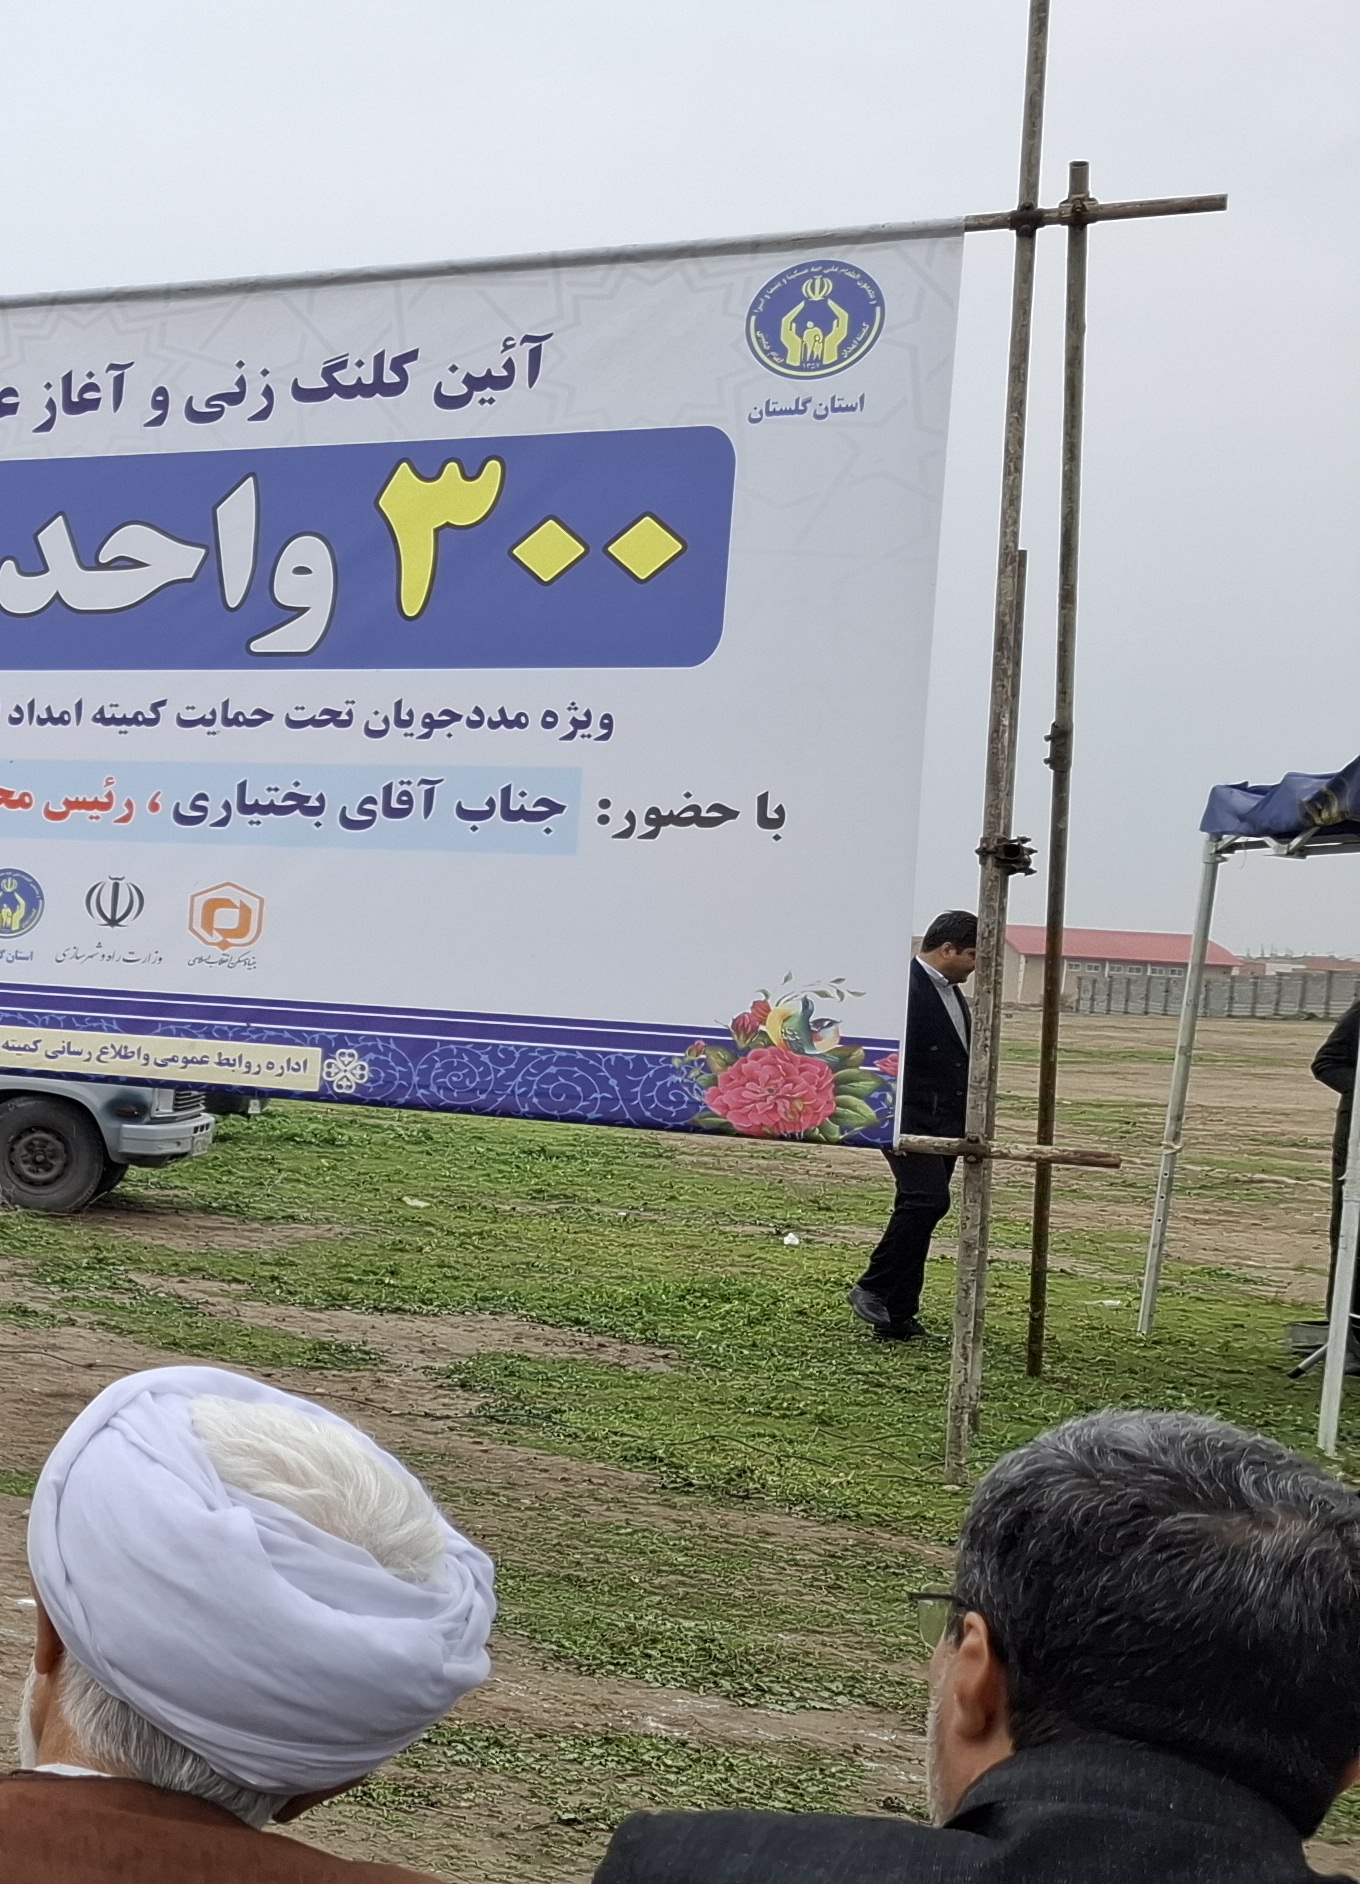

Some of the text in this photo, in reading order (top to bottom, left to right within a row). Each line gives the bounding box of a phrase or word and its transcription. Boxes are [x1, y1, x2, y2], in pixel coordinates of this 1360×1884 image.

[184, 358, 276, 424] زنی
[289, 347, 419, 406] کلنگ
[432, 331, 555, 409] آئین
[32, 359, 134, 434] آغاز
[142, 385, 168, 429] و
[748, 393, 865, 424] استان گلستان
[376, 454, 688, 620] ۳۰۰
[6, 698, 83, 728] امداد
[89, 698, 169, 735] کمیته
[175, 696, 274, 735] حمایت
[285, 700, 354, 732] تحت
[362, 698, 530, 741] مددجویان
[540, 701, 615, 743] ویژه
[42, 776, 134, 823] رئیس
[172, 776, 326, 832] بختیاری
[338, 776, 444, 832] آقای
[454, 781, 567, 834] جناب
[596, 791, 740, 841] حضور:
[754, 791, 787, 843] با
[6, 949, 34, 963] استان
[122, 951, 162, 964] وزارت
[2, 1037, 42, 1056] کمیته
[44, 1041, 92, 1062] رسانی
[153, 1052, 210, 1069] عمومی
[214, 1052, 261, 1075] روابط
[265, 1057, 308, 1077] اداره
